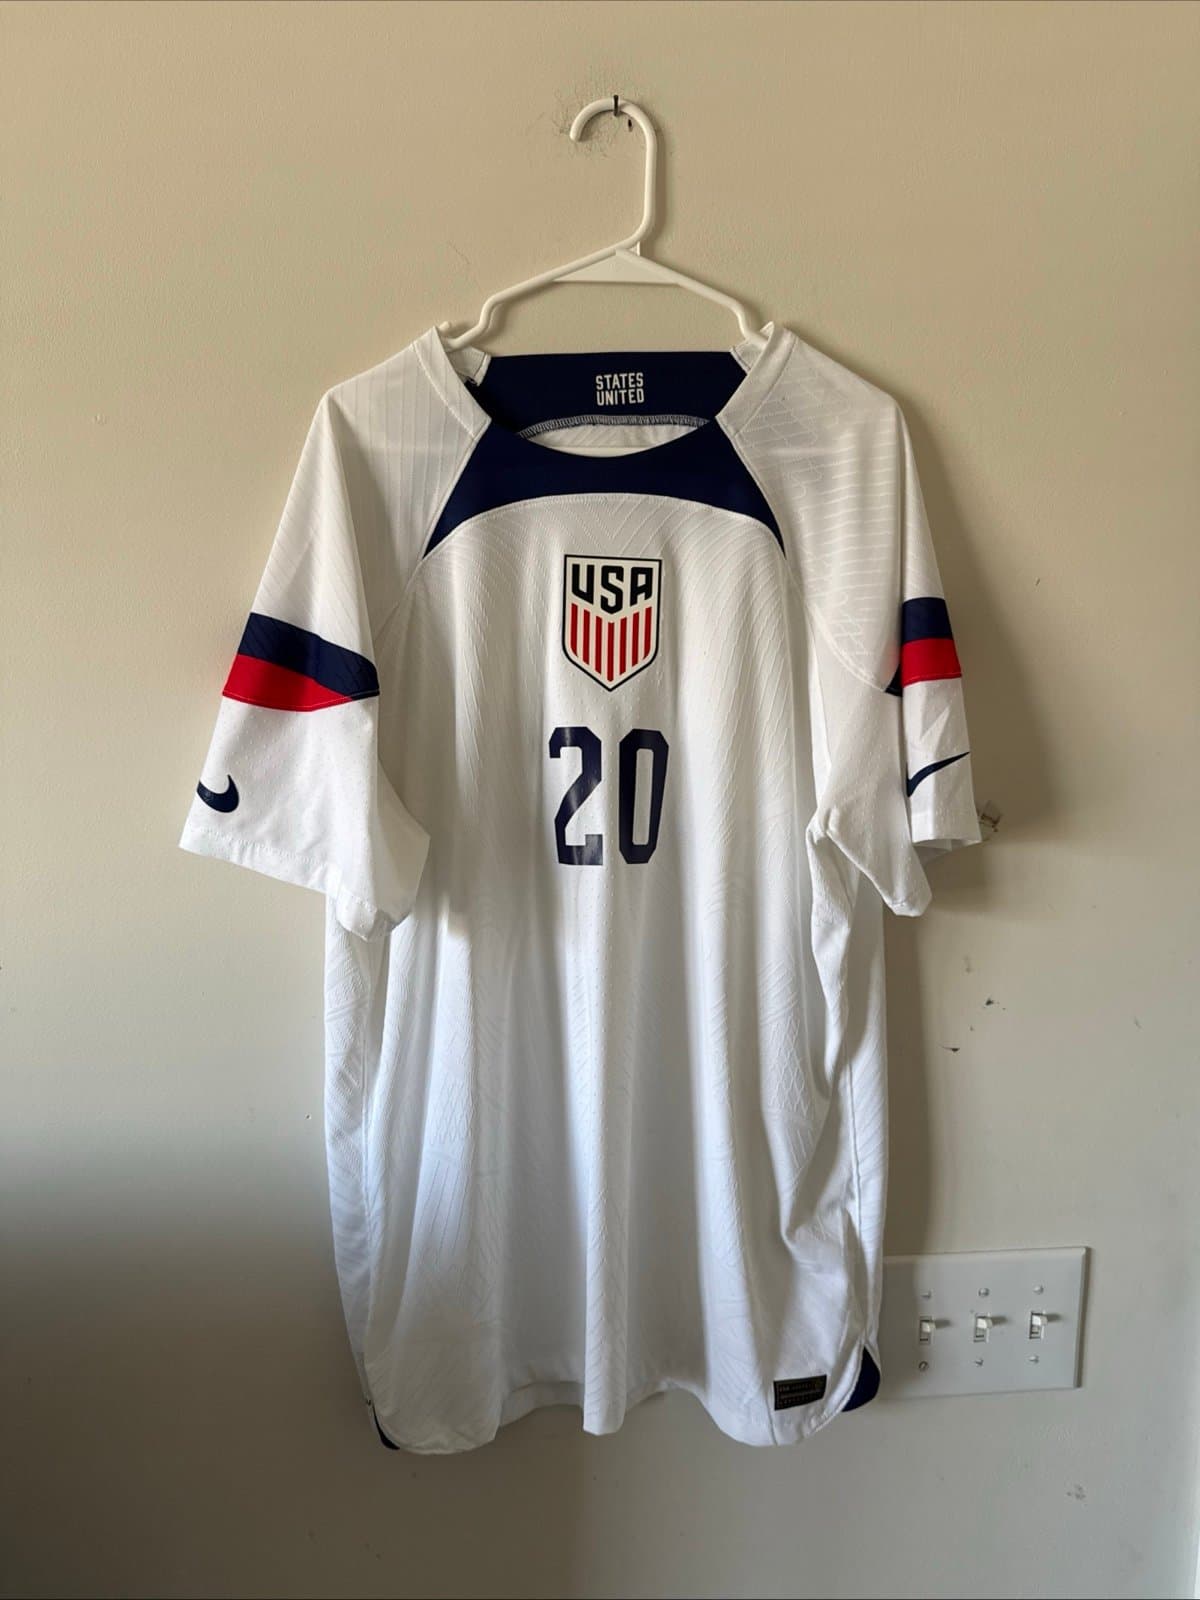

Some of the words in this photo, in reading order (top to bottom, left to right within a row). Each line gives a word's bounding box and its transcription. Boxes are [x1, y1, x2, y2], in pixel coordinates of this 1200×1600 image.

[595, 372, 644, 390] STATES
[596, 388, 645, 406] UNITED
[571, 563, 654, 614] USA
[548, 726, 669, 866] 20
